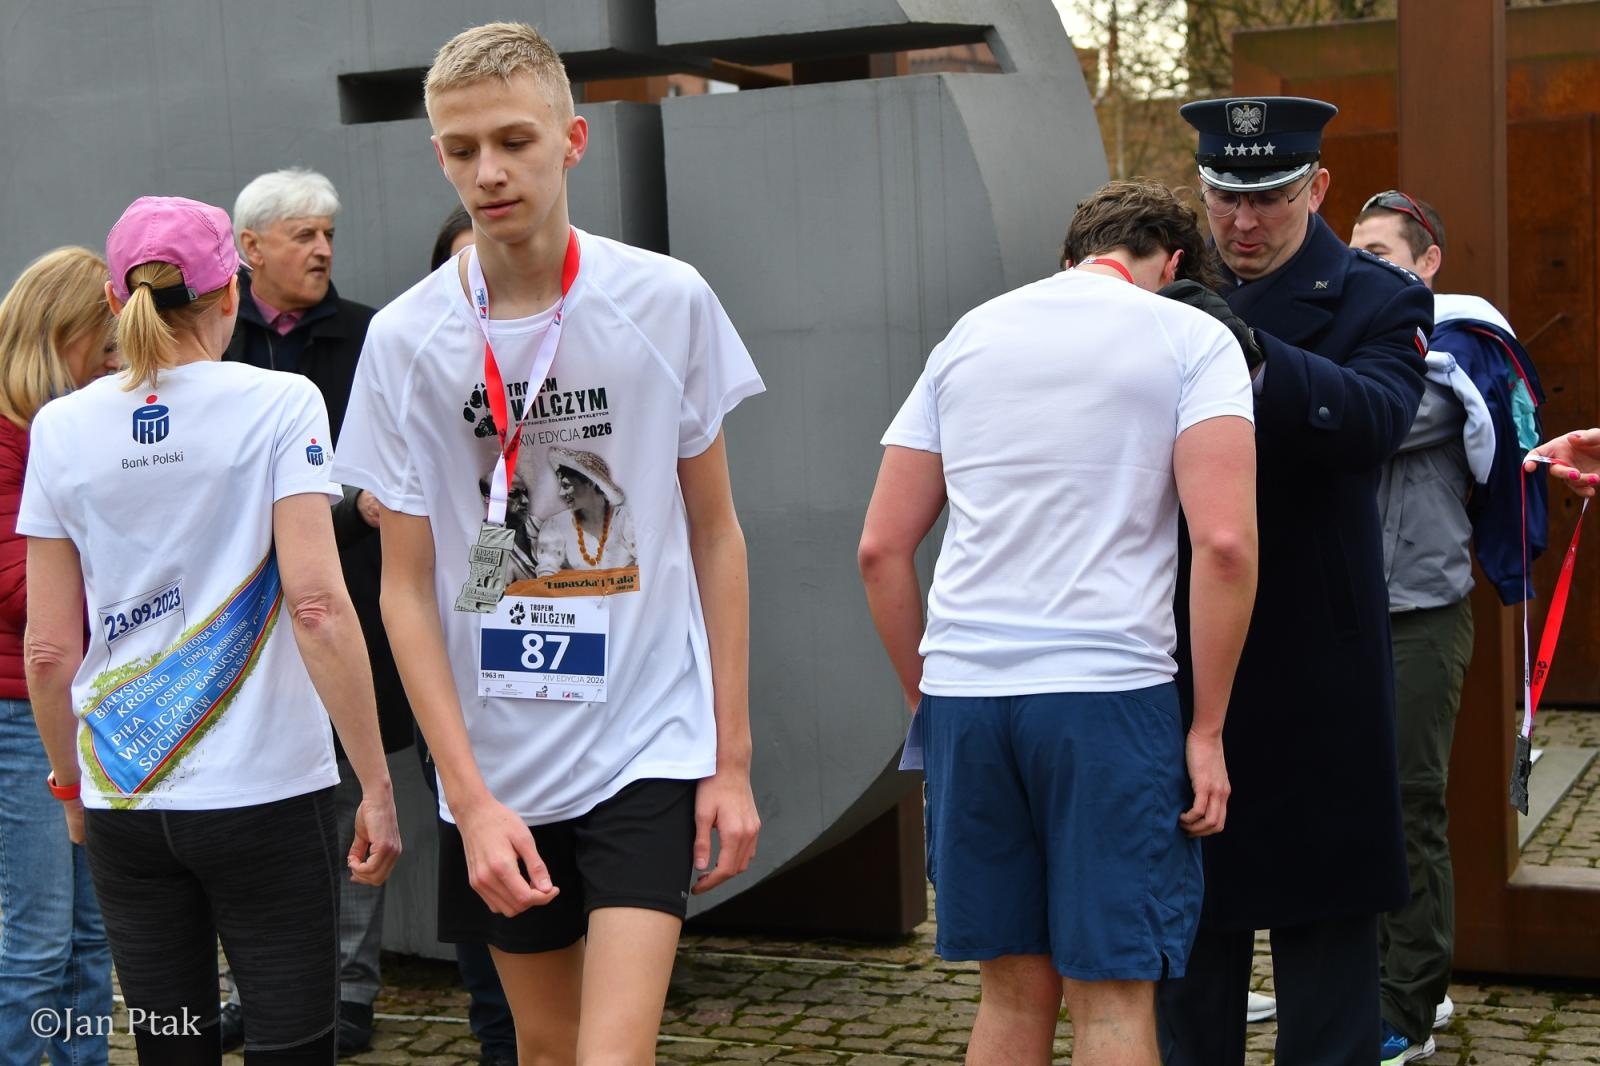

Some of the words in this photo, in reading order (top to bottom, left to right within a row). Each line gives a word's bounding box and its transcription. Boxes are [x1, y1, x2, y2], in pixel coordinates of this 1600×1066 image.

[506, 378, 558, 397] TROEM
[511, 387, 608, 422] WILCZYM
[519, 433, 536, 447] XIV
[538, 428, 581, 445] EDYCJA
[582, 422, 613, 439] 2026
[121, 456, 149, 469] Bank
[153, 451, 184, 465] Polski
[104, 586, 181, 642] 23.09.2023
[530, 603, 554, 612] TROPEM
[530, 612, 576, 625] WILCZYM
[520, 633, 571, 670] 87
[94, 672, 154, 720] BIAŁYSTOK
[177, 630, 213, 657] ZIELONA
[481, 671, 497, 679] 1963
[586, 676, 605, 685] 2026
[116, 674, 170, 718] KROSNO
[118, 695, 195, 761] WIELICZKA
[196, 630, 254, 692] BARUCHOWO
[110, 717, 146, 747] PIŁA
[138, 695, 212, 772] SOCHACZEW
[216, 668, 239, 690] RUDA
